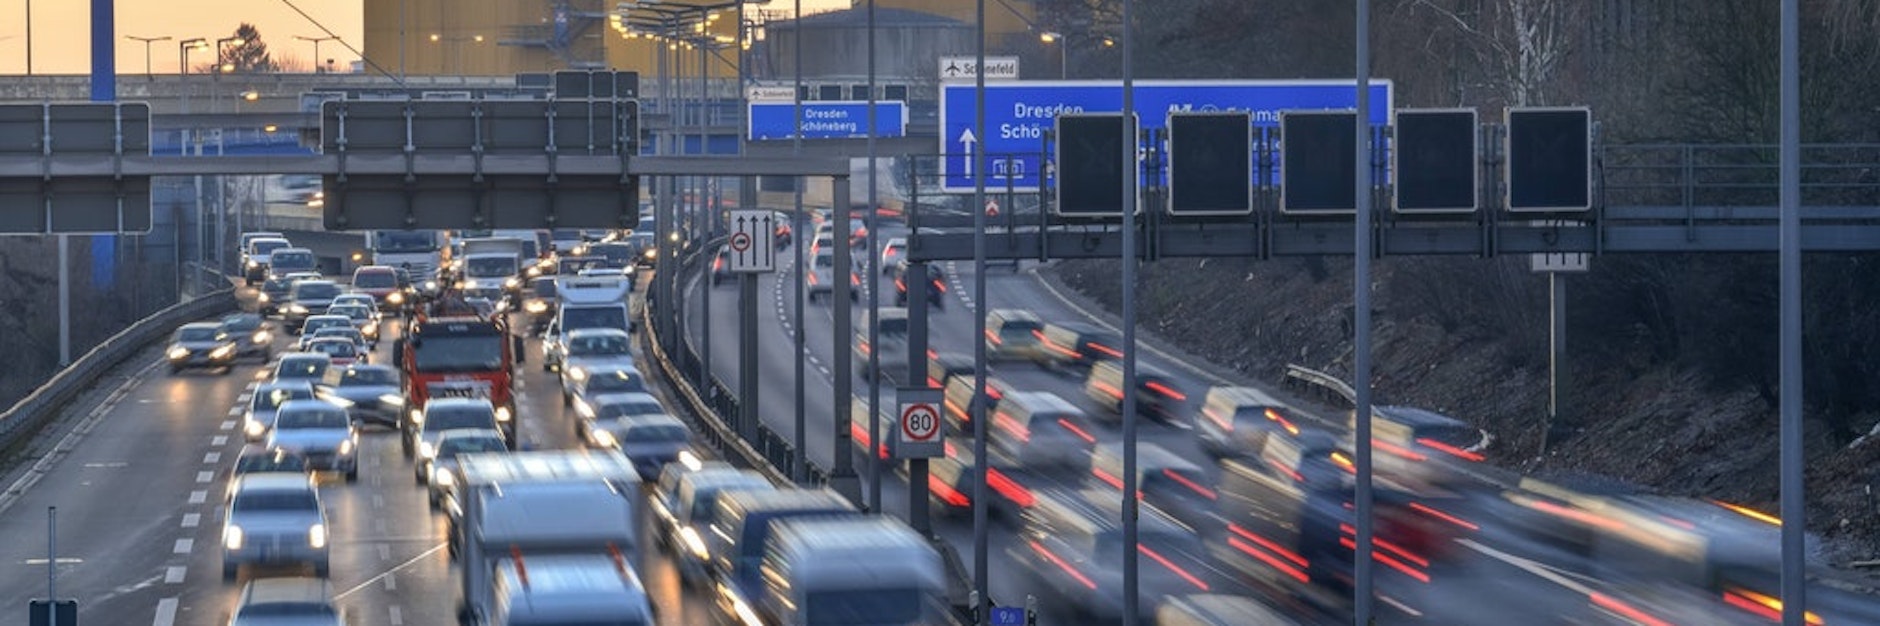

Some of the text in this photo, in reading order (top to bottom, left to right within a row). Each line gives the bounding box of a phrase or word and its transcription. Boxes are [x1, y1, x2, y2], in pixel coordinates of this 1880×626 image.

[964, 63, 1014, 74] Schnefeld
[806, 109, 848, 118] Dresden
[1014, 102, 1083, 117] Dresden
[1001, 124, 1040, 138] Schö
[911, 414, 931, 431] 80
